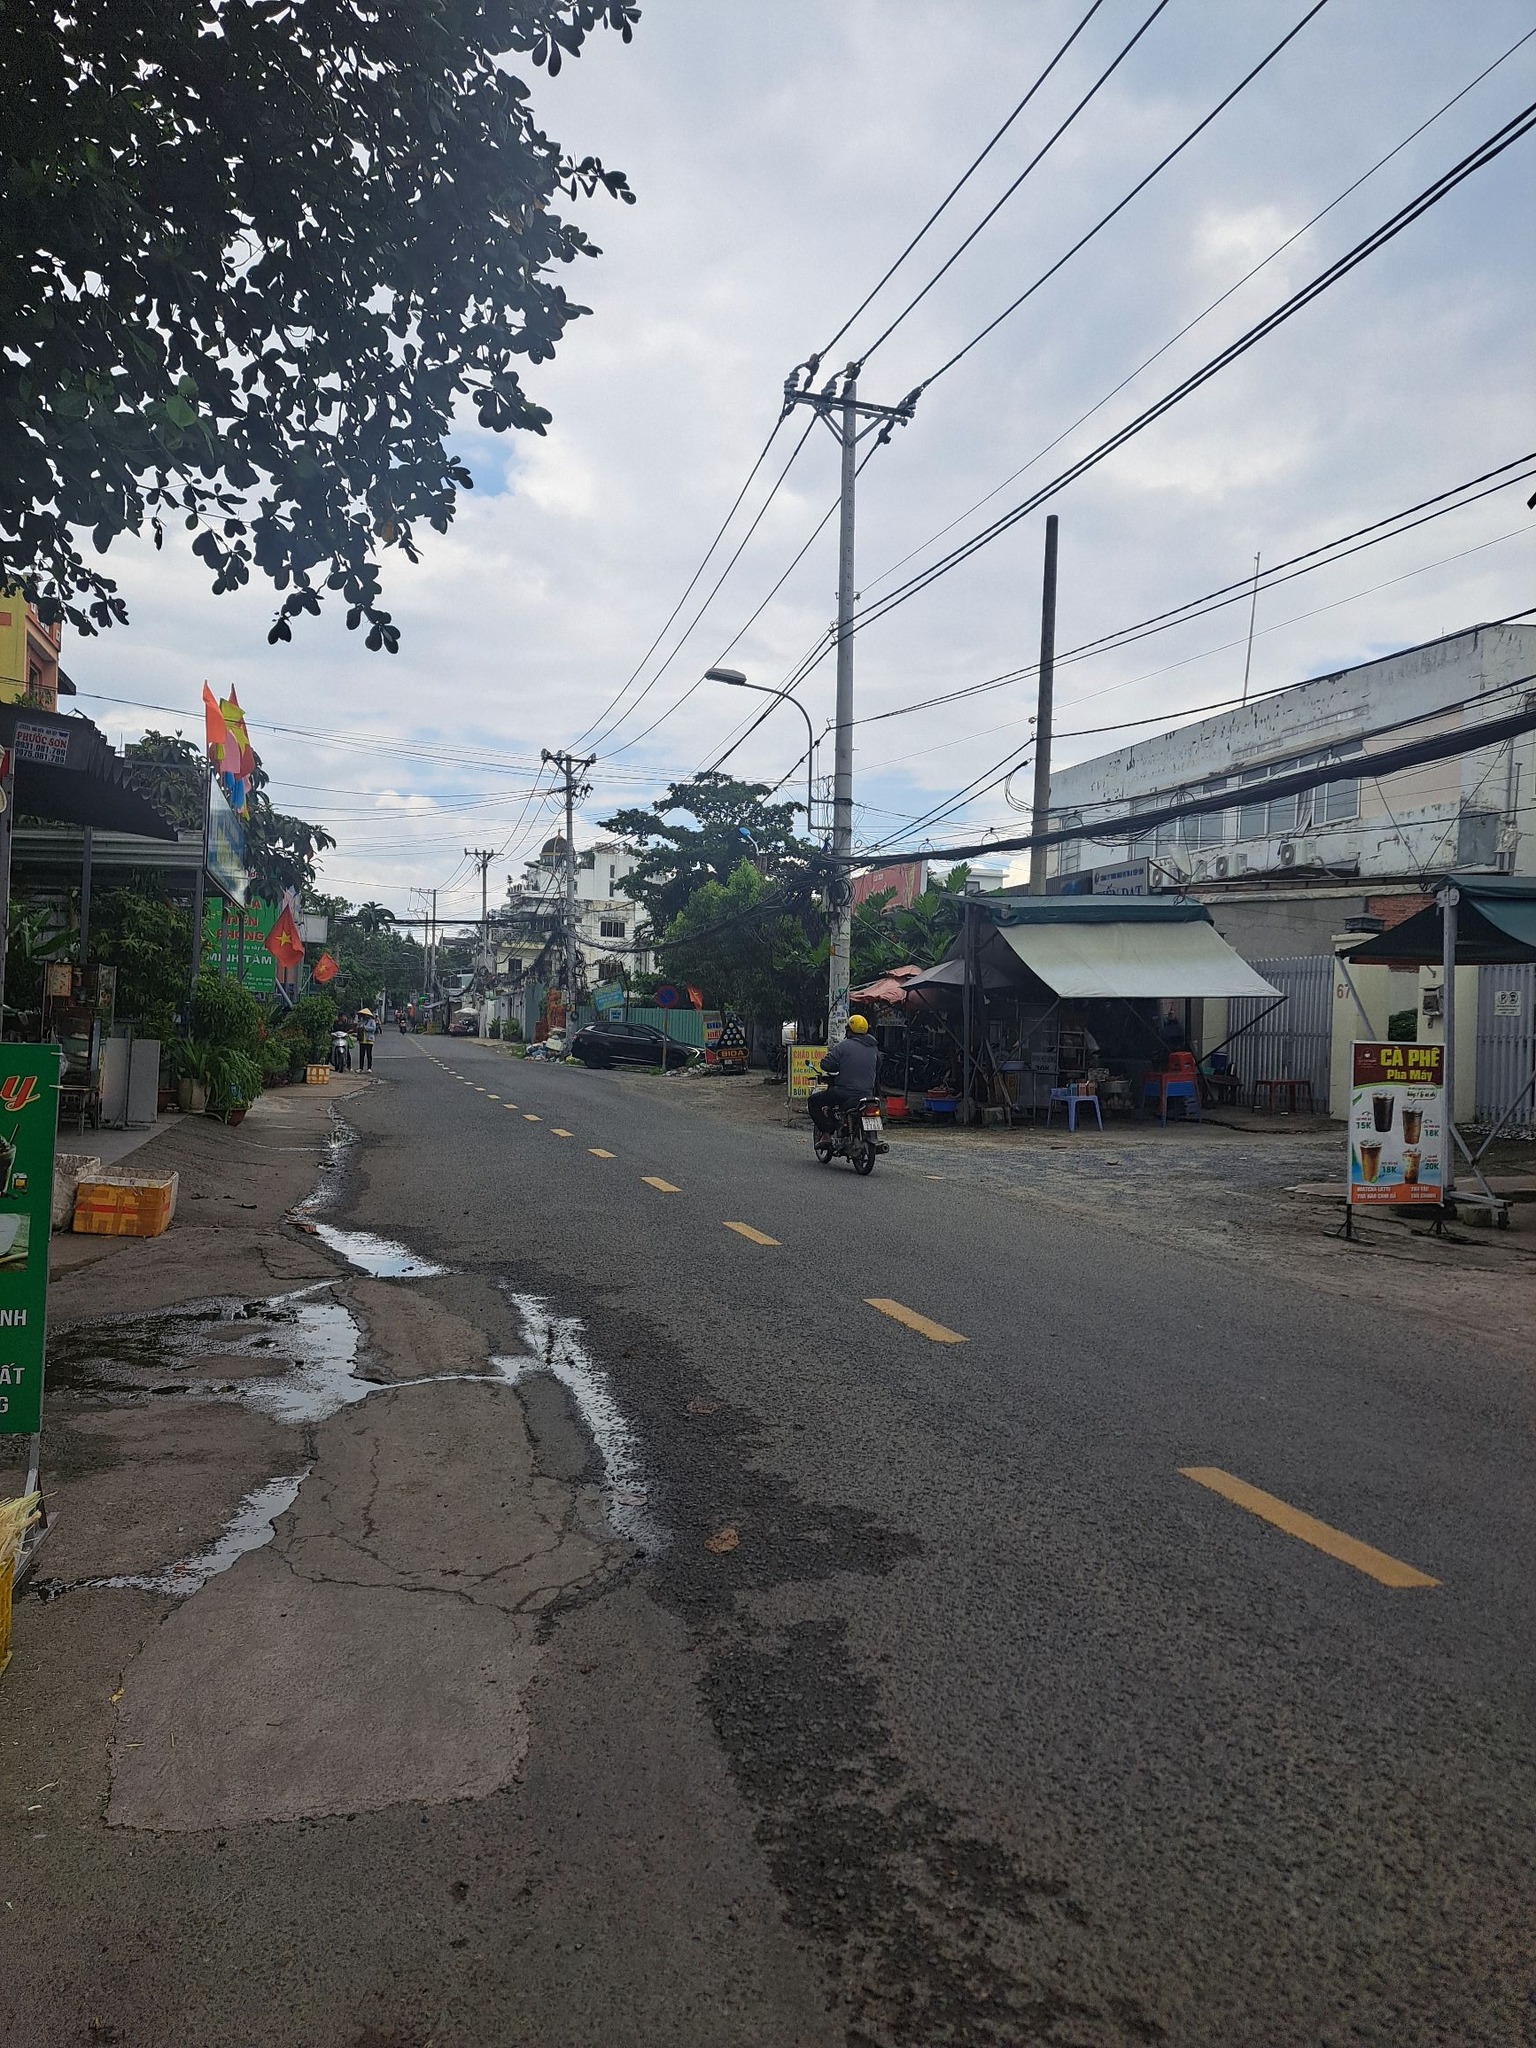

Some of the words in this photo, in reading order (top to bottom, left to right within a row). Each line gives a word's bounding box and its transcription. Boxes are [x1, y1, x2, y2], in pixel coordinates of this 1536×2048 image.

[17, 732, 48, 745] PHƯỚC
[15, 741, 66, 756] 0931.081.789
[1380, 1046, 1404, 1067] CÀ
[1408, 1047, 1441, 1068] PHÊ
[1386, 1069, 1408, 1080] Pha
[1409, 1069, 1433, 1082] Máy
[1356, 1122, 1372, 1130] 15K
[1424, 1129, 1440, 1137] 18K
[1424, 1162, 1440, 1170] 20K
